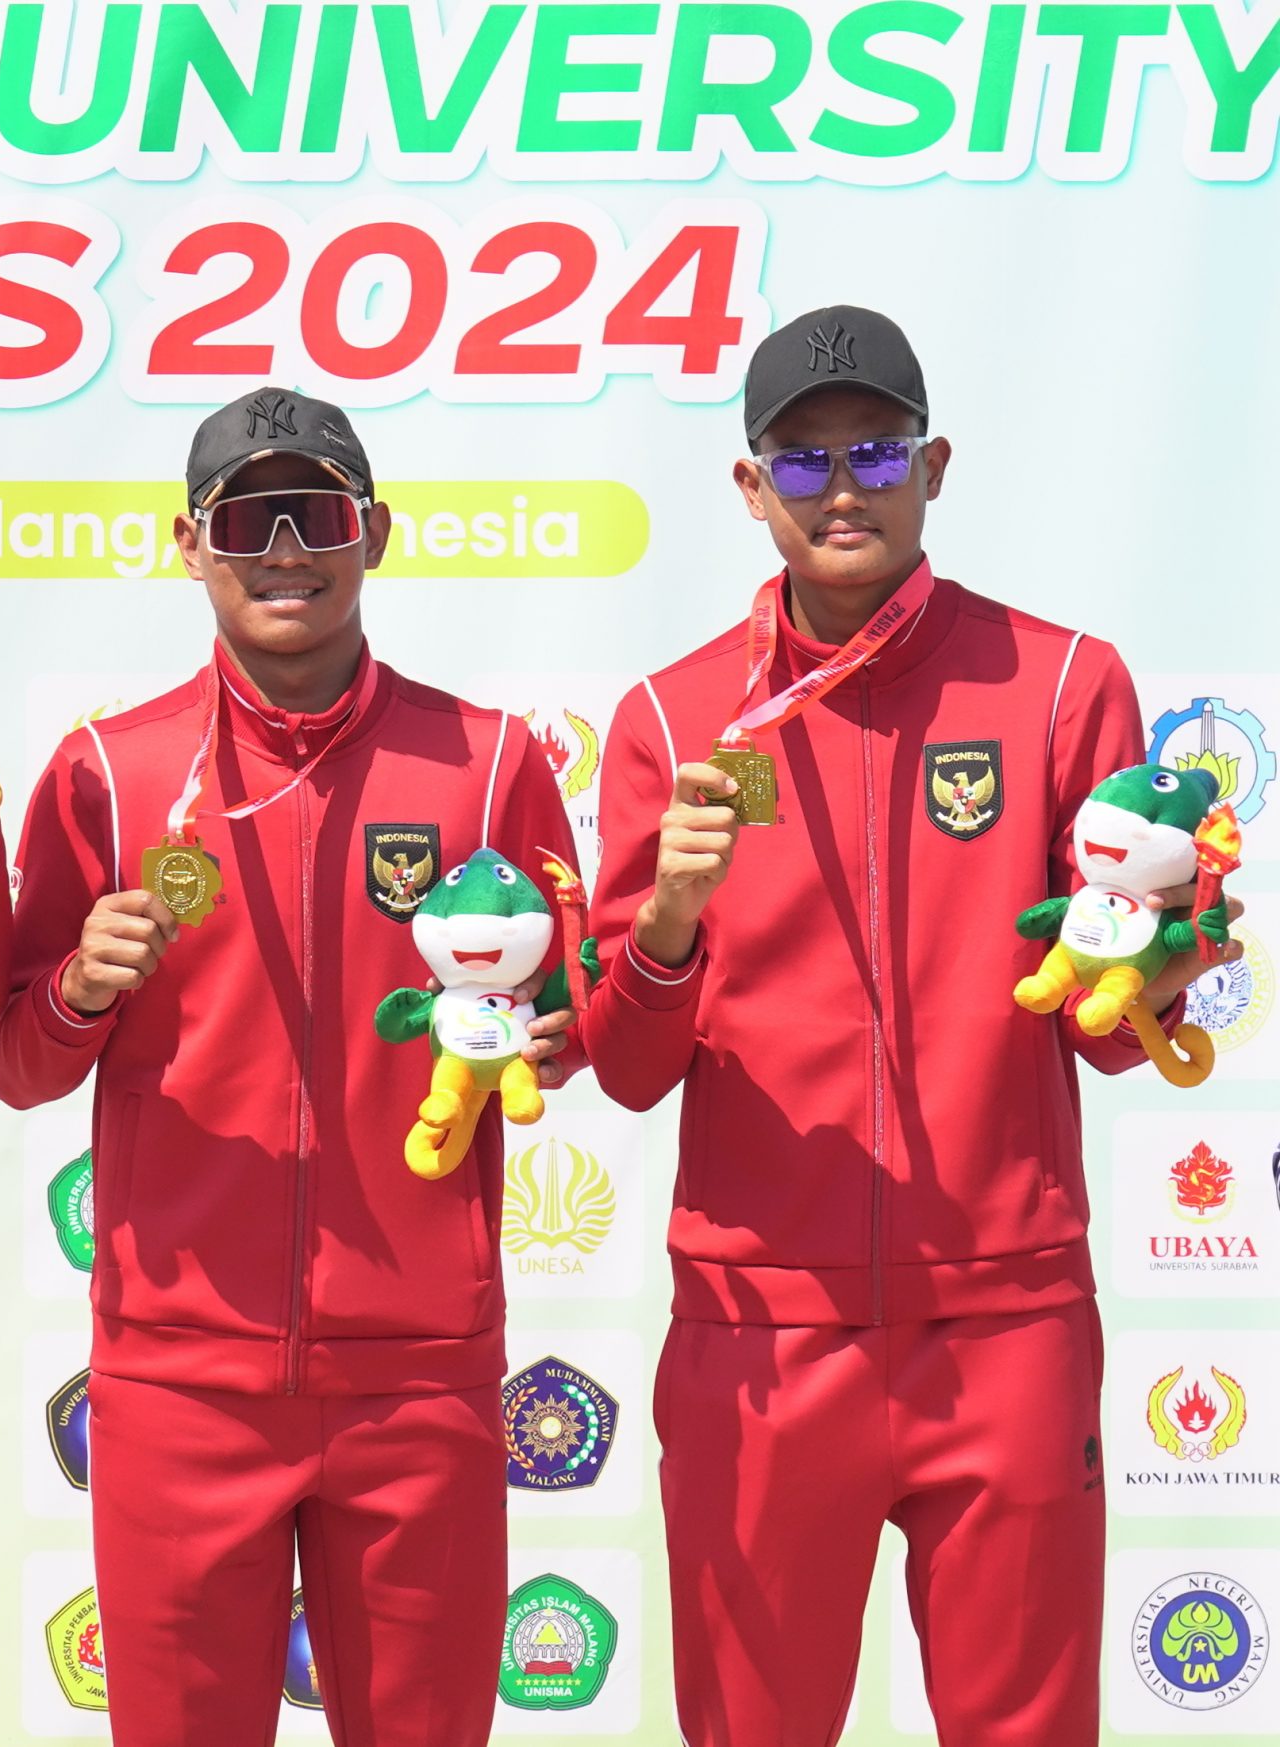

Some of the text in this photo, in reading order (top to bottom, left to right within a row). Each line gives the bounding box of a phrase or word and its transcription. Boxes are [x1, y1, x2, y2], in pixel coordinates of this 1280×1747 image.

[147, 221, 743, 379] 2024
[391, 495, 579, 557] nesia
[863, 611, 897, 645] ASEAN
[818, 638, 868, 682] UNIVERSITY
[791, 678, 822, 704] GAMES
[935, 752, 990, 765] INDONESIA
[376, 833, 429, 844] INDONESIA
[67, 1169, 92, 1236] UNIVERSIT
[1149, 1236, 1259, 1258] UBAYA
[517, 1257, 585, 1275] UNESA
[1150, 1262, 1258, 1271] UNIVERSITAS SURABAYA
[59, 1386, 88, 1426] UNIVER
[545, 1368, 611, 1442] MUHAMMADIYAH
[524, 1473, 577, 1487] MALANG
[1126, 1472, 1280, 1485] KONI JAWA TIMUR
[502, 1596, 599, 1671] UNIVERSITAS ISLAM MALANG
[1137, 1577, 1265, 1703] UNIVERSITAS NEGERI MALANG
[63, 1629, 84, 1684] UNIVERSITAS
[1182, 1662, 1220, 1684] UM
[86, 1686, 107, 1699] JAW
[524, 1687, 573, 1697] UNISMA
